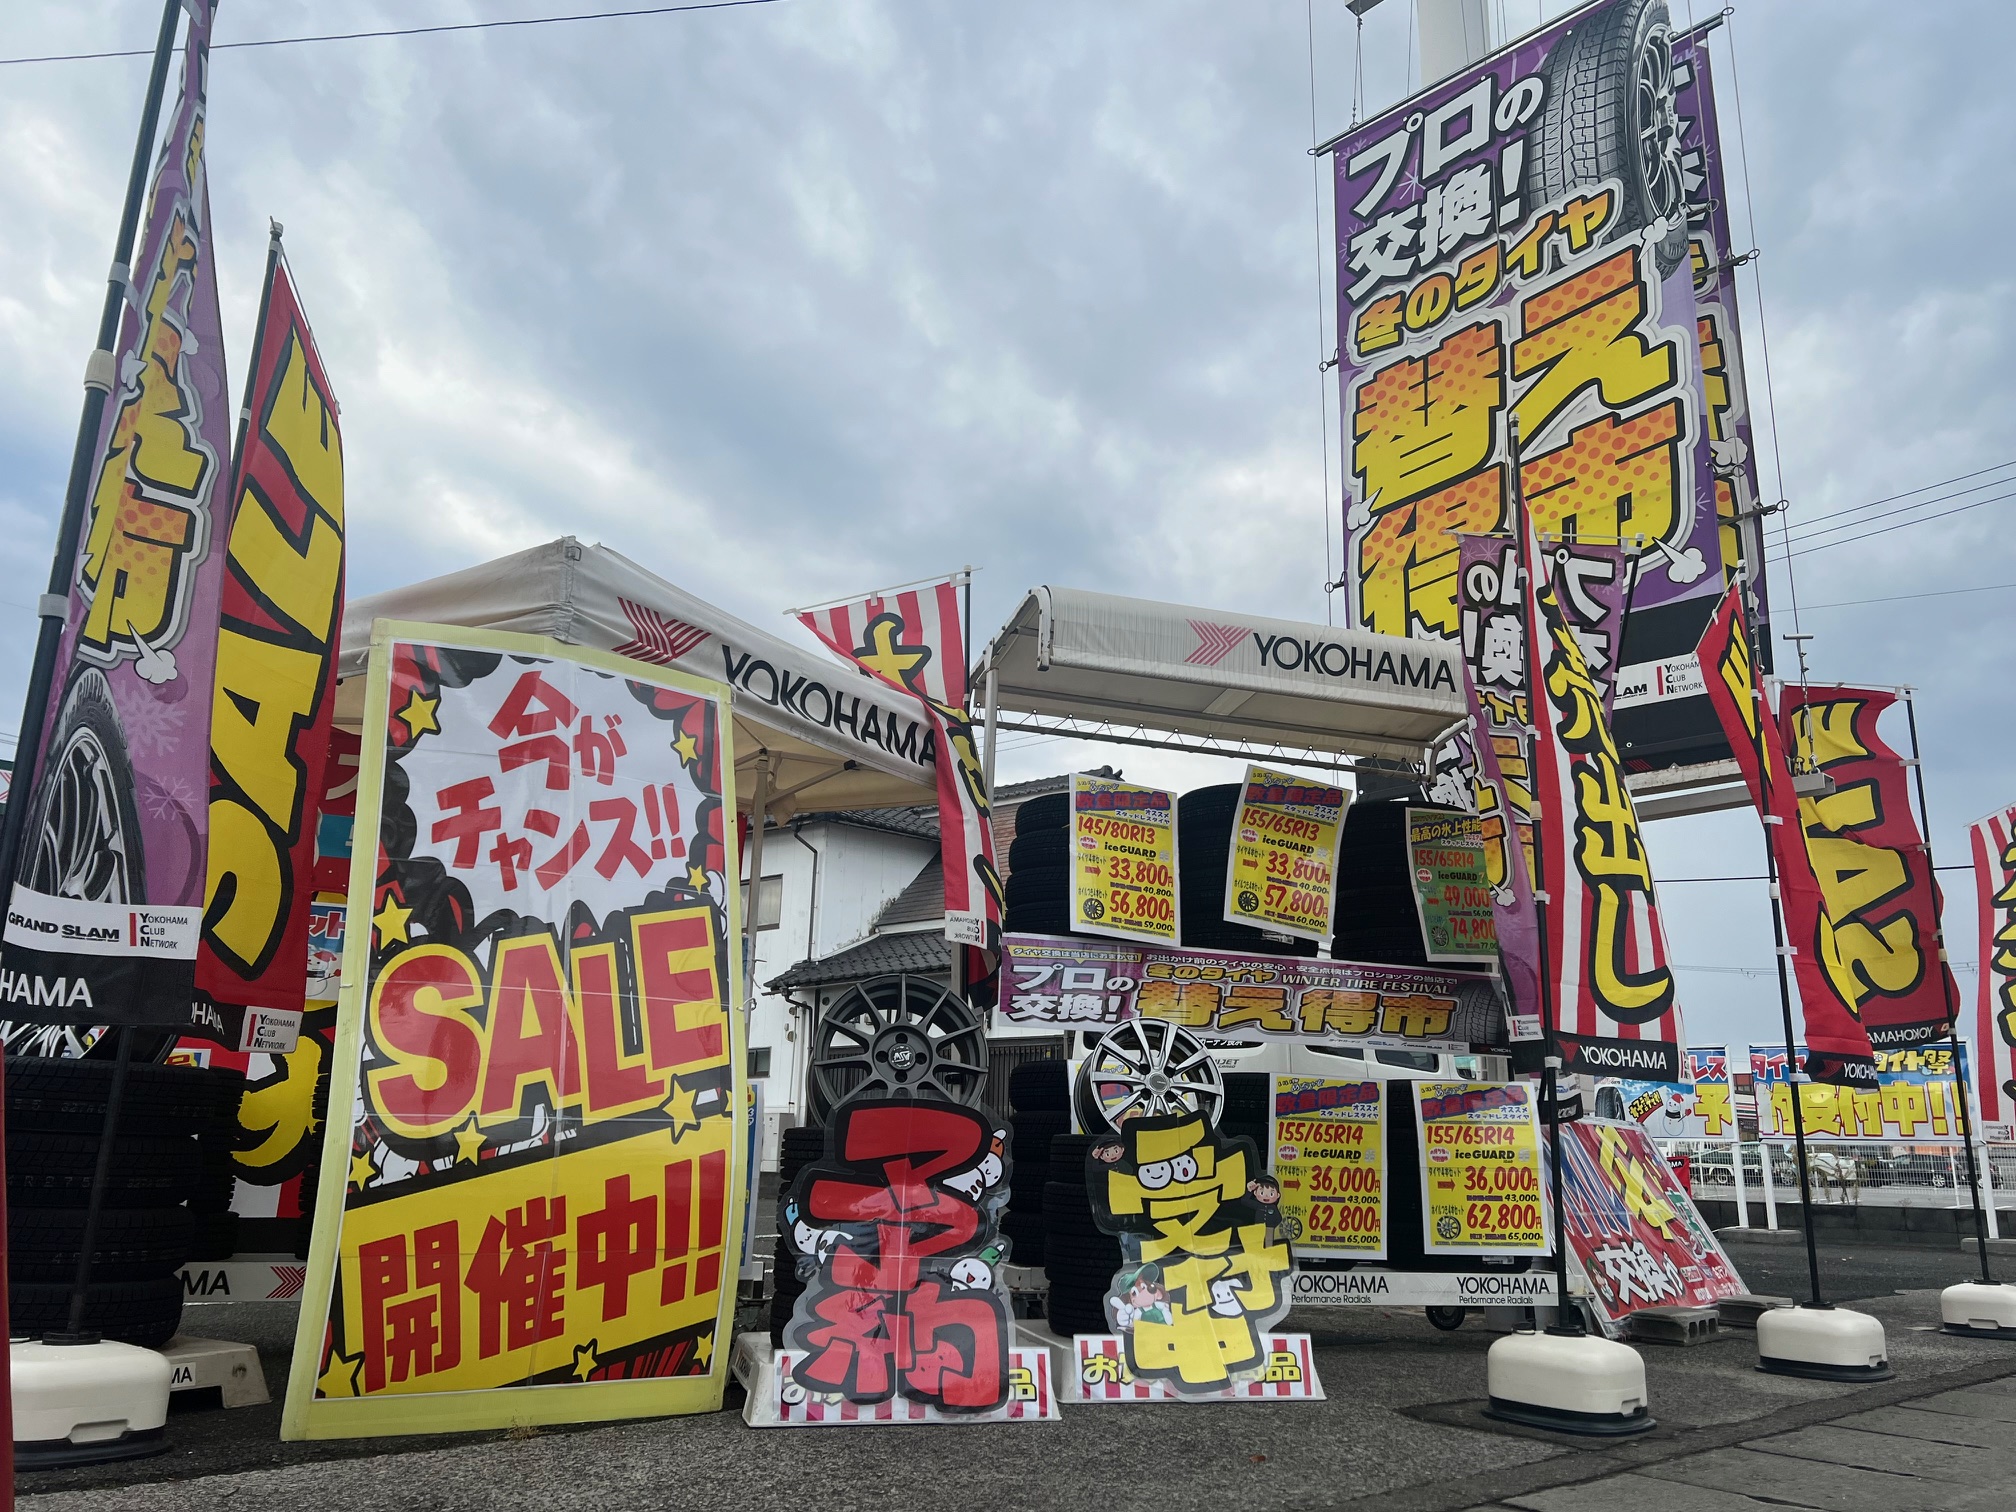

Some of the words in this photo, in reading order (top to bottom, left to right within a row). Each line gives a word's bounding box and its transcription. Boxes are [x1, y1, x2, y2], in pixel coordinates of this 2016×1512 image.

[1348, 75, 1543, 218] プロの
[1346, 144, 1523, 301] 交換!
[1356, 189, 1610, 353] 冬のタイヤ
[1253, 632, 1457, 693] YOKOHAMA
[1664, 661, 1700, 673] YOKOHAM
[1665, 674, 1686, 683] CLUB
[1666, 682, 1703, 694] NETWORK
[722, 645, 938, 768] YOKOHAMA
[487, 671, 627, 792] 今が
[1145, 809, 1169, 818] オススメ
[1242, 807, 1320, 841] 155/65R13
[1315, 805, 1339, 815] オススメ
[431, 776, 687, 891] チャンス!!
[1078, 816, 1155, 844] 145/80R13
[1411, 818, 1482, 842] 最高の氷上性能
[1109, 856, 1173, 887] 33,800円
[1266, 851, 1330, 885] 33,800円
[1414, 849, 1474, 868] 155/65R14
[1110, 890, 1174, 922] 56,800円
[1264, 884, 1328, 919] 57,800円
[8, 912, 58, 934] GRAND
[62, 924, 120, 940] SLAM
[139, 912, 188, 926] YOKOHAMA
[140, 925, 165, 936] CLUB
[140, 937, 178, 950] NETWORK
[1012, 963, 1135, 992] プロの
[1146, 962, 1276, 983] 冬のタイヤ
[1282, 974, 1340, 988] WINTER
[1345, 977, 1378, 990] TIRE
[1382, 980, 1450, 995] FESTIVAL
[259, 1014, 296, 1028] YOKOHAMA
[370, 908, 728, 1134] SALE
[1011, 992, 1123, 1022] 交換!
[1135, 980, 1454, 1037] 替え得市
[257, 1027, 276, 1038] CLUB
[1579, 1045, 1667, 1070] YOKOHAMA
[1352, 1103, 1378, 1111] オススメ
[1278, 1122, 1363, 1145] 155/65R14
[1427, 1126, 1515, 1145] 155/65R14
[1309, 1165, 1381, 1194] 36,000円
[1464, 1166, 1538, 1194] 36,000円
[1309, 1204, 1381, 1234] 62,800円
[1467, 1203, 1542, 1232] 62,800円
[805, 1106, 1001, 1408] 予約
[1107, 1118, 1293, 1384] 受付中
[359, 1149, 727, 1394] 開催中!!
[1290, 1275, 1389, 1294] YOKOHAMA
[1456, 1276, 1550, 1294] YOKOHAMA
[1291, 1295, 1342, 1305] Performance
[1343, 1295, 1371, 1304] Radials
[1459, 1296, 1506, 1305] Performance
[1507, 1296, 1533, 1305] Radials
